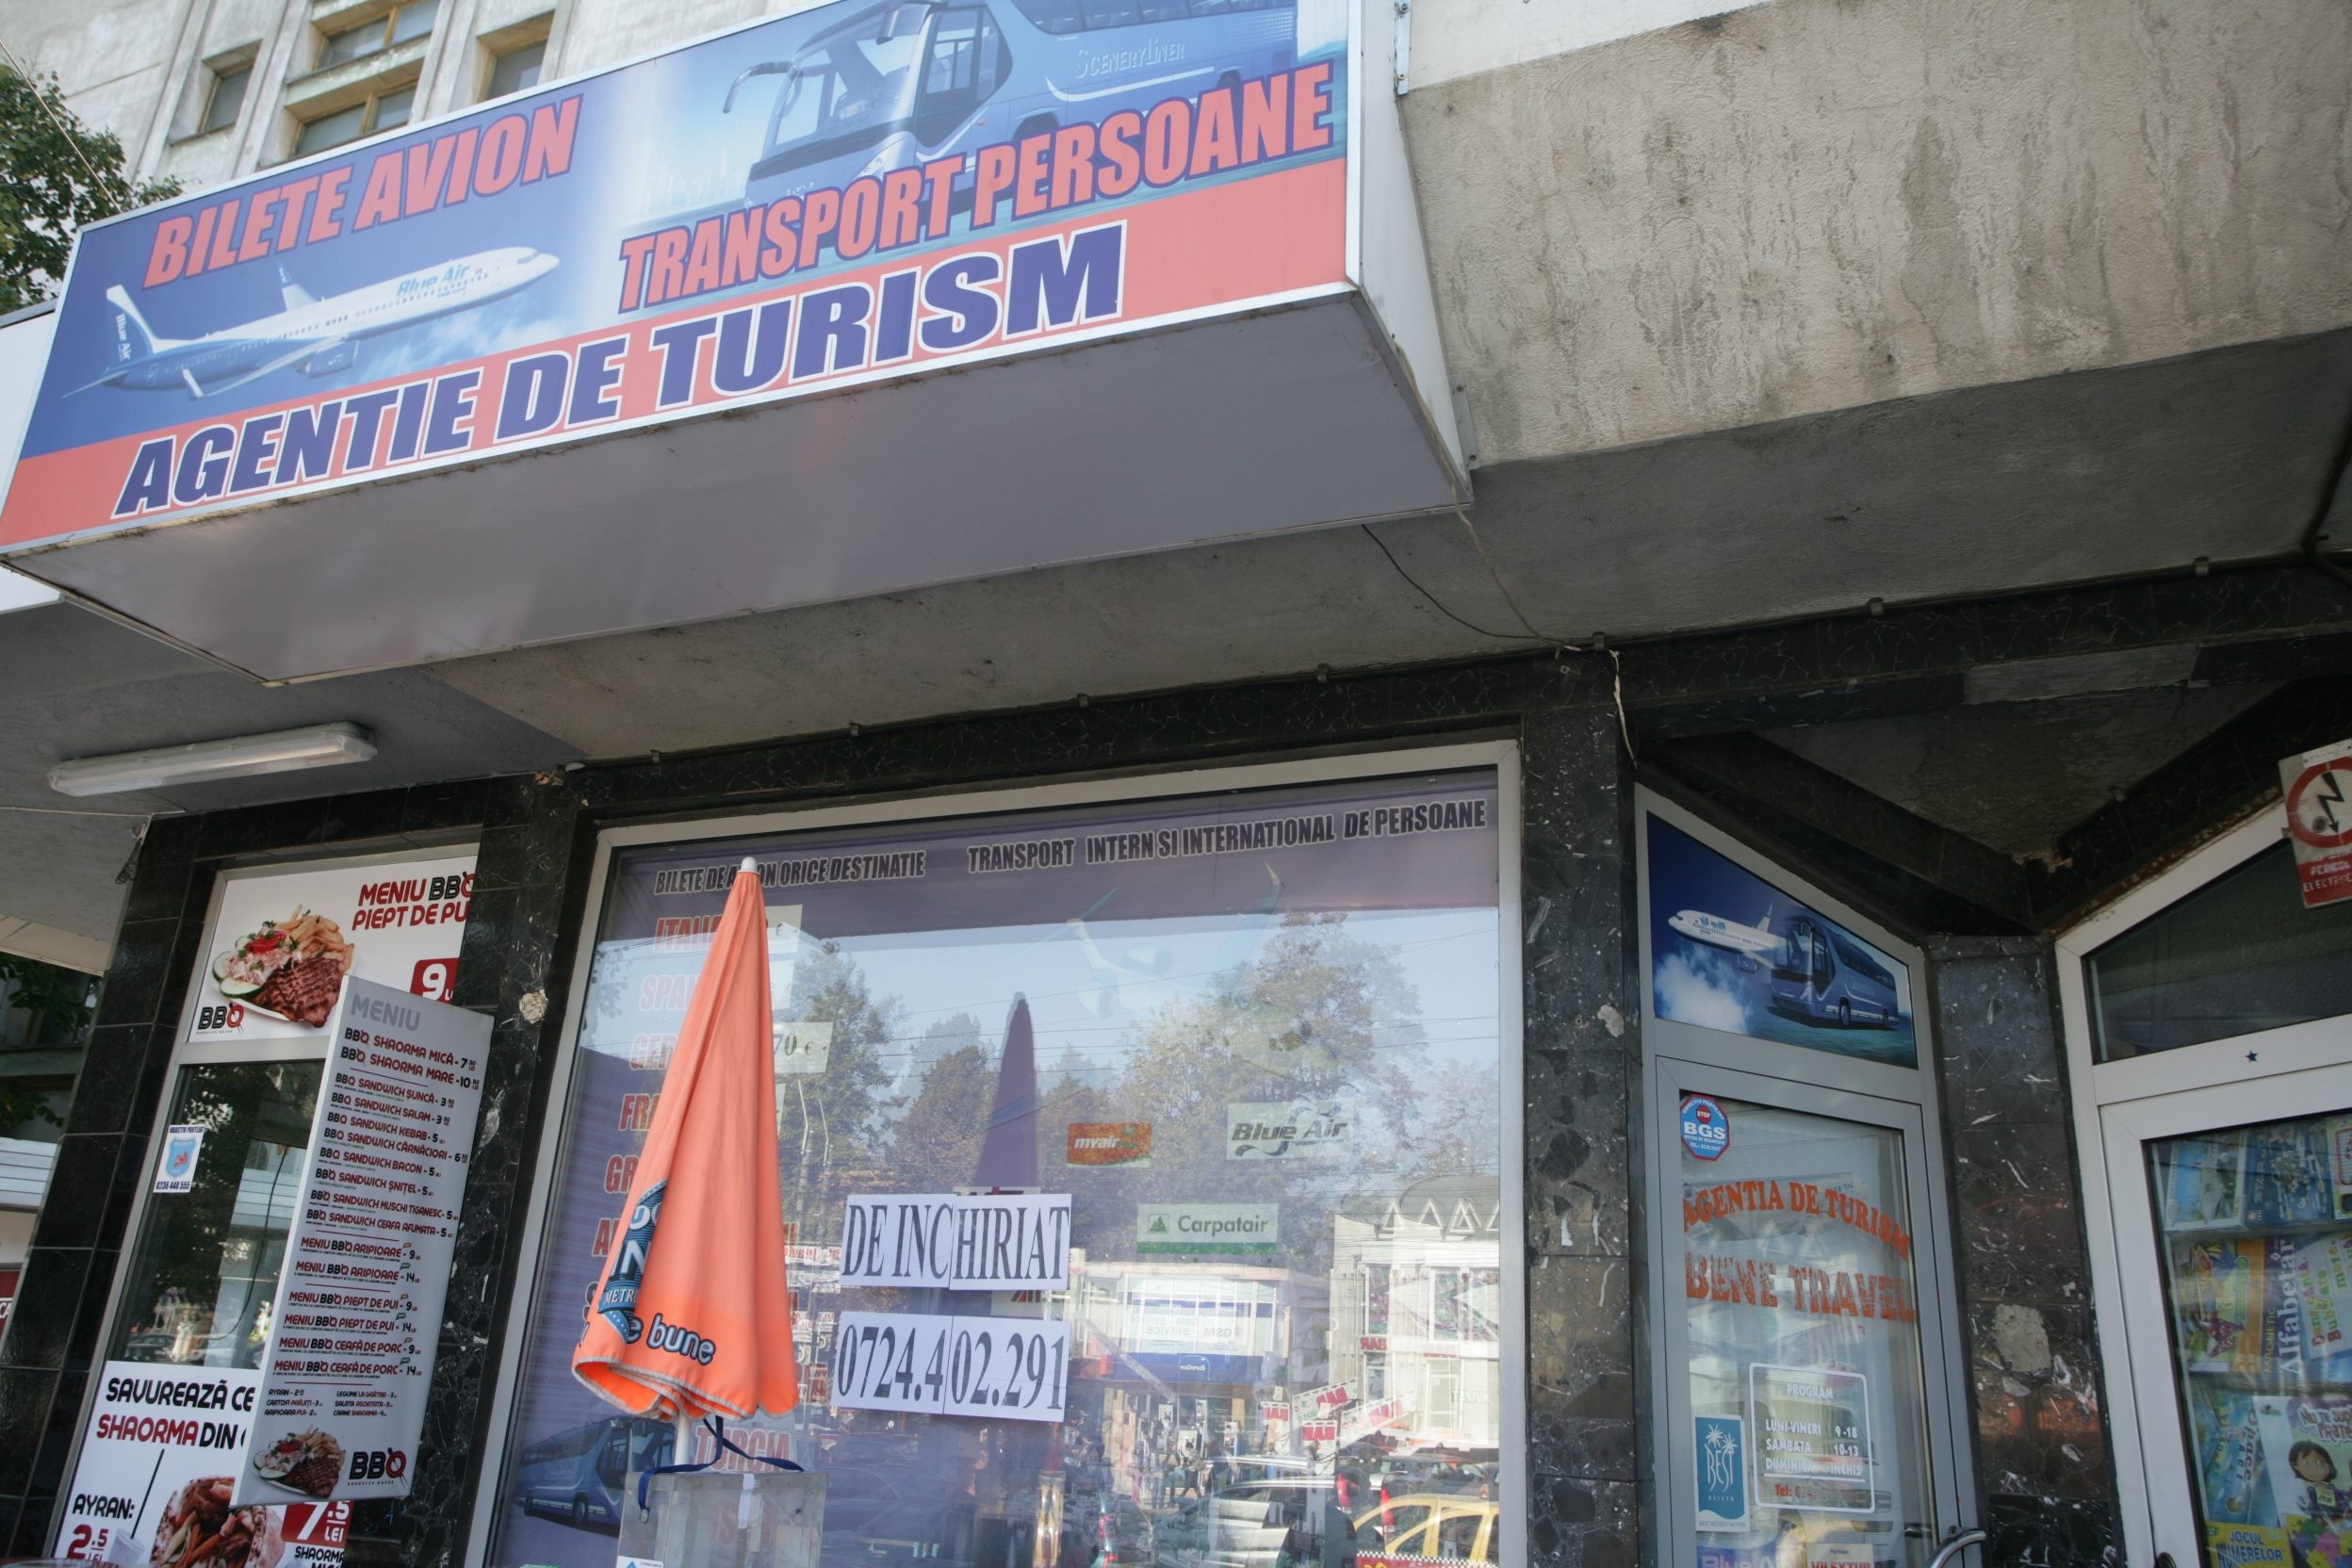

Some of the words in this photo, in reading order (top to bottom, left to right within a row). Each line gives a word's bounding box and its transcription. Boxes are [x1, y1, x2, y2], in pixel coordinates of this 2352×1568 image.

[141, 166, 351, 291] BILETE
[351, 93, 584, 231] AVION
[618, 154, 969, 315] TRANSPORT
[970, 58, 1334, 229] PERSOANE
[442, 264, 470, 283] Air
[111, 366, 484, 520] AGENTIE
[493, 333, 630, 445] DE
[651, 219, 1128, 412] TURISM
[967, 838, 1075, 874] TRANSPORT
[1086, 829, 1154, 865] INTERN
[1158, 828, 1181, 859] SI
[1181, 813, 1335, 857] INTERNATIONAL
[1343, 810, 1370, 841] DE
[1374, 799, 1487, 837] PERSOANE
[654, 867, 705, 895] BILETE
[705, 866, 725, 891] DE
[778, 858, 827, 887] ORICE
[829, 850, 925, 881] DESTINATIE
[358, 879, 427, 906] MENIU
[351, 906, 409, 931] PIEPT
[410, 904, 439, 926] DE
[422, 963, 447, 1000] 9
[198, 1003, 244, 1030] BBQ
[351, 994, 420, 1031] MENIU
[345, 1027, 369, 1046] BBQ
[374, 1036, 426, 1058] SHAORMA
[429, 1050, 454, 1066] MICĂ
[341, 1046, 366, 1065] BBQ
[370, 1054, 423, 1076] SHAORMA
[426, 1068, 454, 1084] MARE
[335, 1074, 355, 1086] BBQ
[358, 1079, 404, 1097] SANDWICH
[332, 1093, 351, 1104] BBQ
[354, 1098, 401, 1116] SANDWICH
[403, 1108, 432, 1122] SALAM
[328, 1112, 347, 1124] BBQ
[351, 1117, 398, 1135] SANDWICH
[1232, 1122, 1297, 1141] Blue
[1302, 1119, 1348, 1139] Air
[1684, 1121, 1725, 1139] BGS
[324, 1128, 344, 1140] BBQ
[348, 1133, 395, 1150] SANDWICH
[396, 1142, 448, 1160] CÂRNĂCIORI
[320, 1148, 340, 1159] BBQ
[343, 1152, 391, 1169] SANDWICH
[392, 1160, 422, 1174] BACON
[316, 1168, 335, 1181] BBQ
[339, 1172, 386, 1188] SANDWICH
[311, 1190, 331, 1201] BBQ
[334, 1194, 379, 1208] SANDWICH
[381, 1201, 407, 1213] MUSCHI
[306, 1209, 326, 1220] BBQ
[329, 1213, 376, 1228] SANDWICH
[377, 1219, 400, 1230] CEAFA
[401, 1223, 435, 1235] AFUMATA
[1177, 1215, 1268, 1237] Carpatair
[1683, 1180, 1784, 1232] AGENTIA
[1789, 1182, 1821, 1216] DE
[1824, 1189, 1911, 1262] TURISM
[301, 1237, 330, 1250] MENIU
[331, 1240, 352, 1252] BBQ
[353, 1245, 401, 1258] ARIPIOARE
[841, 1205, 888, 1277] DE
[891, 1203, 1070, 1280] INCHIRIAT
[296, 1262, 325, 1273] MENIU
[327, 1264, 349, 1275] BBQ
[351, 1266, 399, 1281] ARIPIOARE
[406, 1273, 415, 1282] 14
[1685, 1250, 1778, 1309] BENE
[289, 1292, 319, 1303] MENIU
[319, 1293, 342, 1304] BBQ
[343, 1296, 368, 1308] PIEPT
[369, 1298, 382, 1308] DE
[384, 1299, 399, 1309] PUI
[2278, 1239, 2303, 1377] Alfabetar
[285, 1315, 314, 1326] MENIU
[316, 1315, 337, 1327] BBQ
[338, 1318, 365, 1329] PIEPT
[366, 1320, 378, 1330] DE
[379, 1321, 394, 1331] PUI
[402, 1322, 411, 1332] 14
[279, 1337, 309, 1348] MENIU
[311, 1338, 333, 1349] BBQ
[335, 1340, 363, 1351] CEAFĂ
[364, 1342, 376, 1351] DE
[377, 1344, 402, 1353] PORC
[646, 1313, 715, 1365] bune
[2263, 1307, 2278, 1373] MAGNETIC
[274, 1361, 304, 1371] MENIU
[306, 1361, 328, 1372] BBQ
[331, 1362, 358, 1373] CEAFĂ
[359, 1364, 371, 1373] DE
[373, 1365, 399, 1375] PORC
[406, 1366, 416, 1376] 14
[837, 1324, 1065, 1411] 0724.402.291
[106, 1380, 228, 1410] SAVUREAZĂ
[1787, 1383, 1833, 1399] PROGRAM
[96, 1414, 200, 1446] SHAORMA
[199, 1422, 237, 1450] DIN
[1766, 1419, 1821, 1435] LUNI-VINERI
[1835, 1426, 1840, 1437] 9
[1766, 1439, 1811, 1454] SAMBATA
[1834, 1444, 1858, 1457] 10-13
[348, 1447, 407, 1484] BBQ
[1705, 1444, 1735, 1493] BEST
[1766, 1459, 1815, 1473] DUMINICA
[1830, 1463, 1862, 1477] INCHIS
[1775, 1484, 1791, 1497] Tel:
[73, 1494, 135, 1519] AYRAN:
[324, 1528, 344, 1544] LEI
[2230, 1529, 2264, 1544] JOCUL
[2216, 1543, 2283, 1568] NUMERELOR
